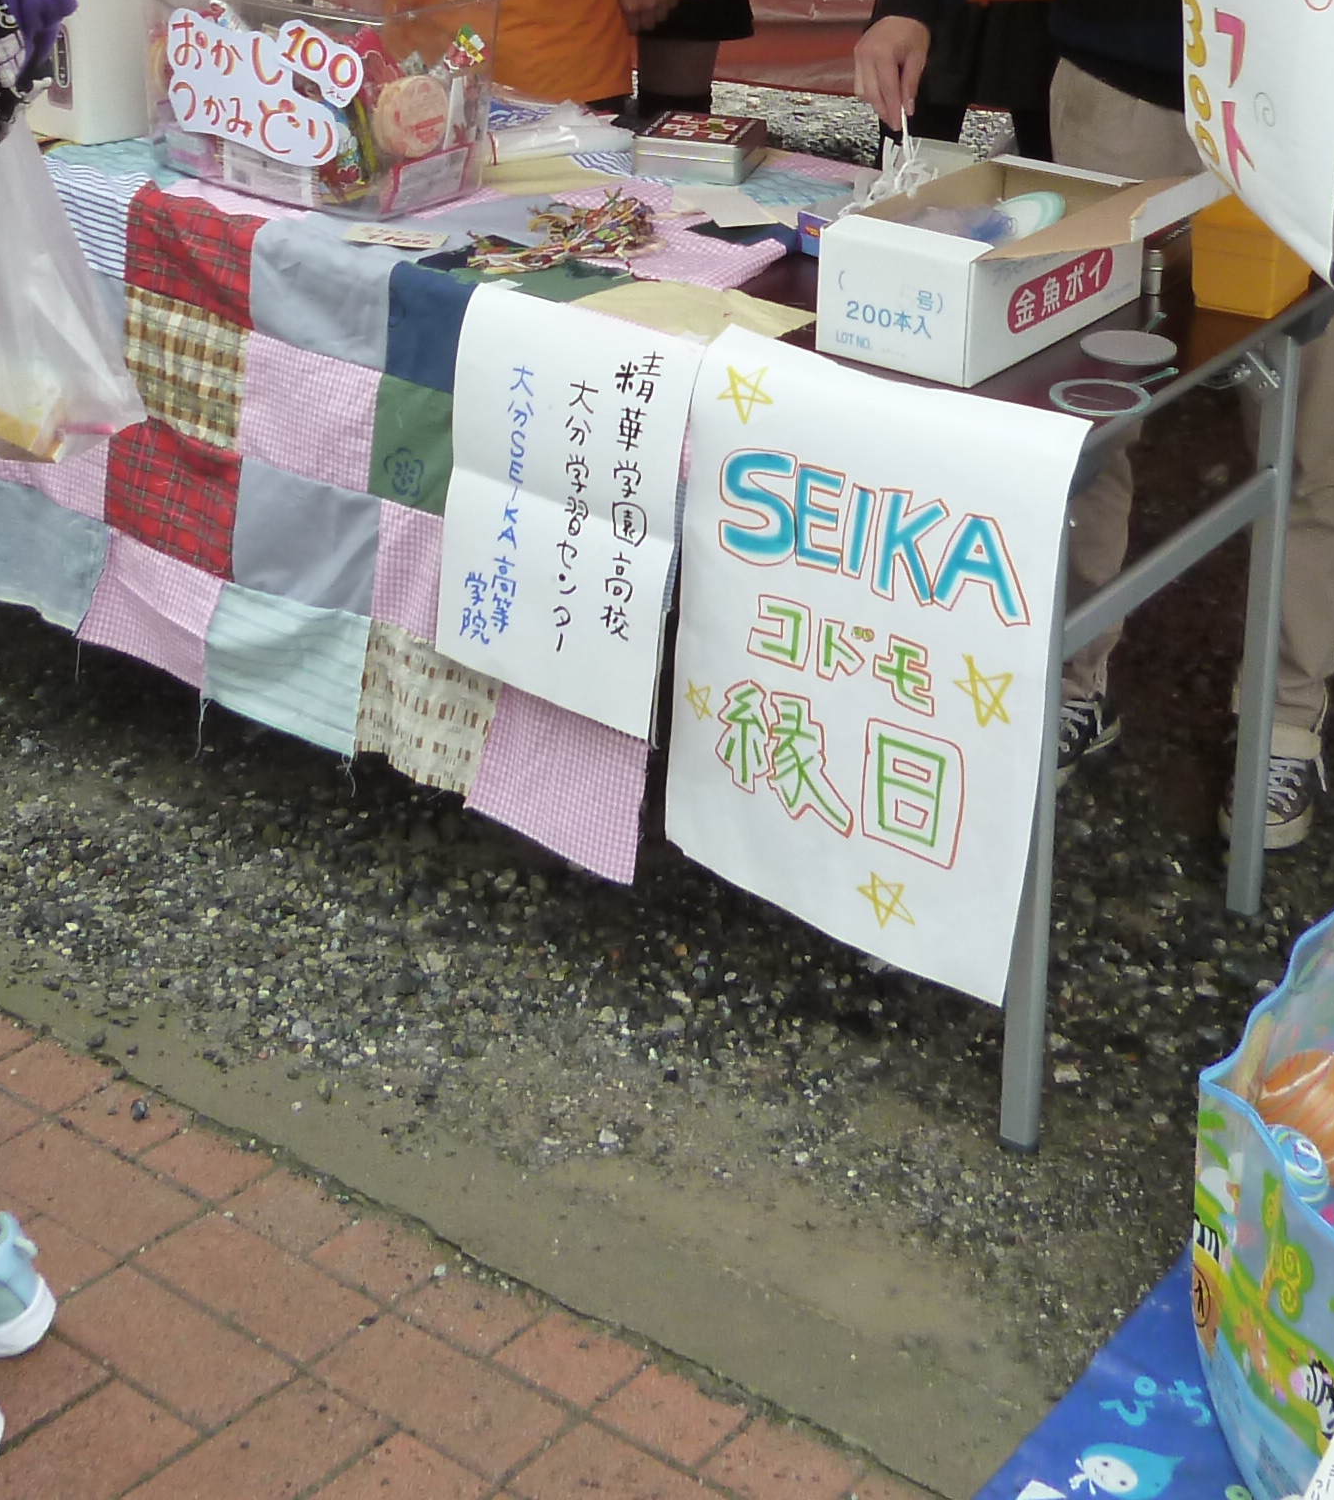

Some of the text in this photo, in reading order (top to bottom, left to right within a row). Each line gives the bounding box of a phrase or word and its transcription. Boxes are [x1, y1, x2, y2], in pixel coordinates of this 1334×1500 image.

[172, 12, 284, 86] おかし
[280, 26, 358, 89] 100
[172, 82, 334, 160] つかみどり
[846, 299, 933, 339] 200本入
[1014, 253, 1107, 329] 金魚ポイ
[835, 329, 855, 346] LOT
[551, 380, 599, 652] 大分学習センター
[600, 350, 666, 642] 精華学園高校
[718, 448, 1030, 625] SEIKA
[747, 594, 934, 717] コドモ
[715, 679, 965, 869] 縁日
